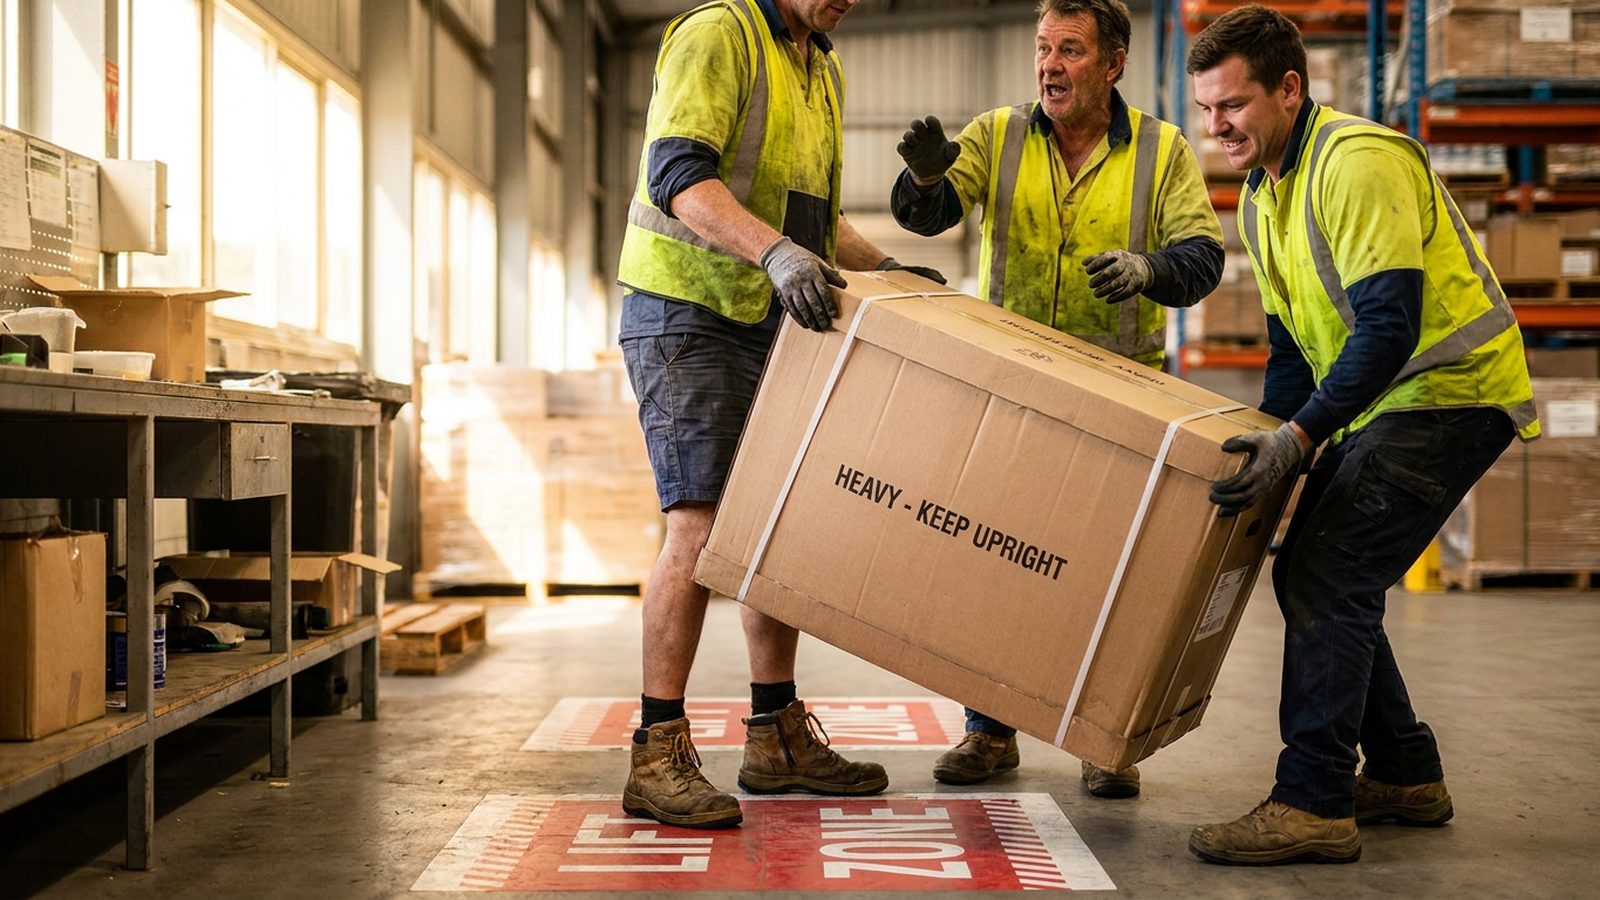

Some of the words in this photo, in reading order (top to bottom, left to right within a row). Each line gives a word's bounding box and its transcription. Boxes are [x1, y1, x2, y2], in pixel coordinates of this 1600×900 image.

[834, 464, 903, 510] HEAVY
[904, 503, 912, 511] -
[916, 499, 970, 538] KEEP
[972, 523, 1068, 580] UPRIGHT
[812, 704, 919, 742] ZONE
[558, 814, 714, 872] LIFT
[819, 807, 972, 878] ZONE
